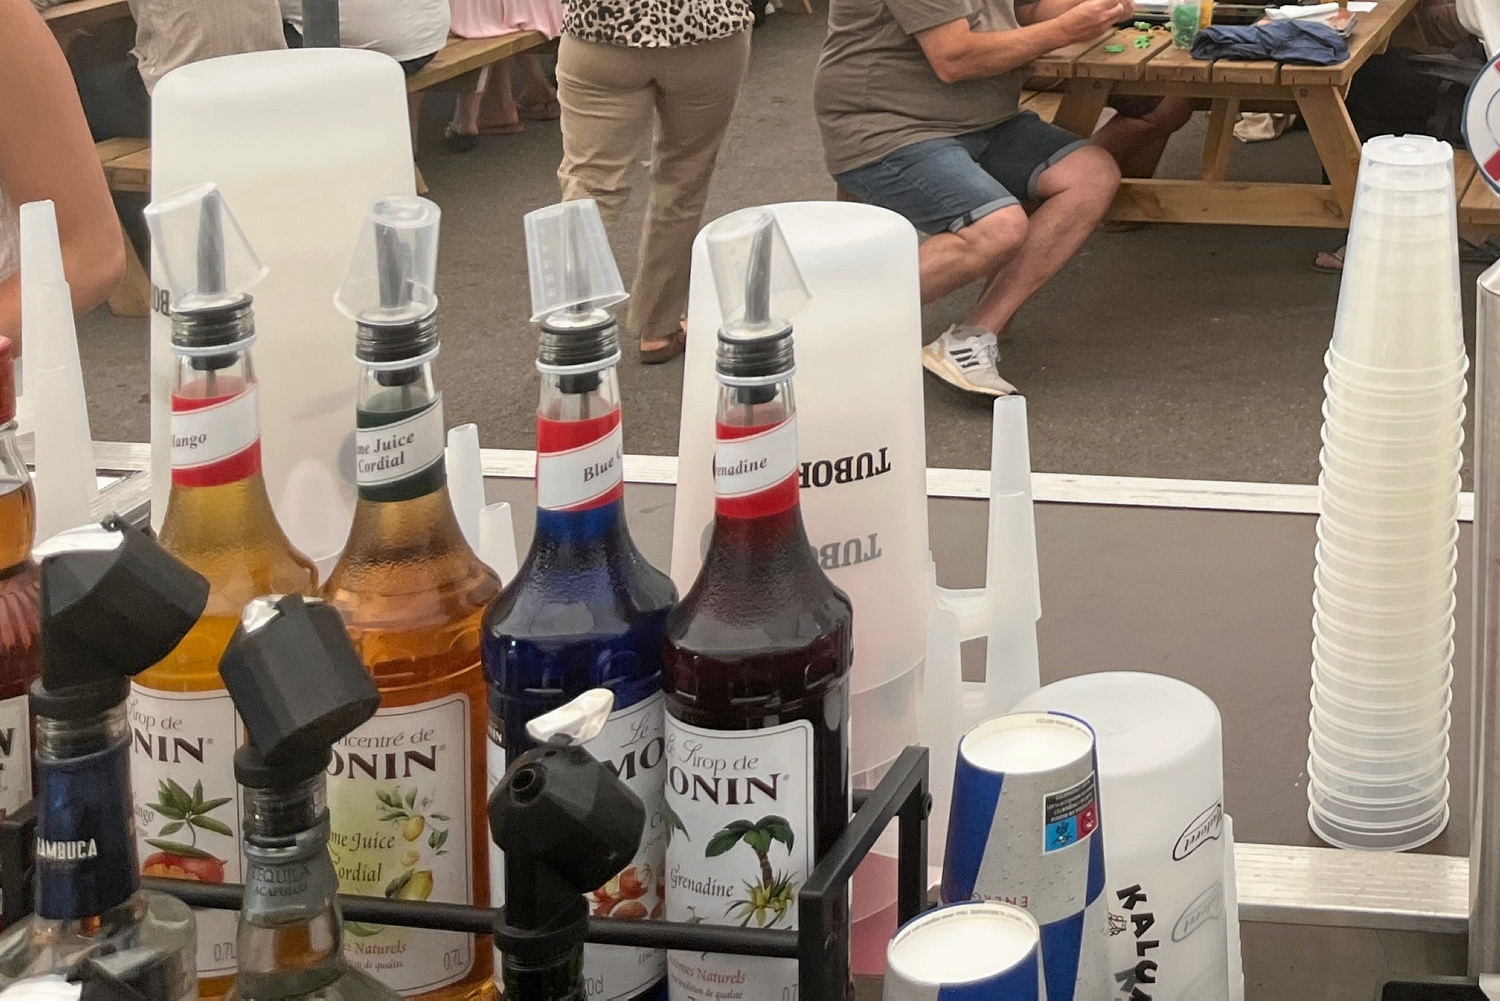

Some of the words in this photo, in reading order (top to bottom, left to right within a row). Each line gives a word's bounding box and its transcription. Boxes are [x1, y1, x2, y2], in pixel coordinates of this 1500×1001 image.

[374, 432, 415, 453] Juice
[359, 451, 405, 473] Cordial
[583, 459, 615, 482] Blue
[161, 716, 182, 731] de
[132, 727, 204, 764] NIN
[337, 731, 405, 749] ncentré
[410, 727, 434, 744] de
[327, 745, 438, 780] ONIN
[679, 739, 726, 777] Sirop
[734, 755, 759, 770] de
[36, 836, 98, 860] AMBUCA
[351, 832, 396, 852] Juice
[252, 865, 312, 883] TEQUILA
[670, 864, 734, 898] Grenadine
